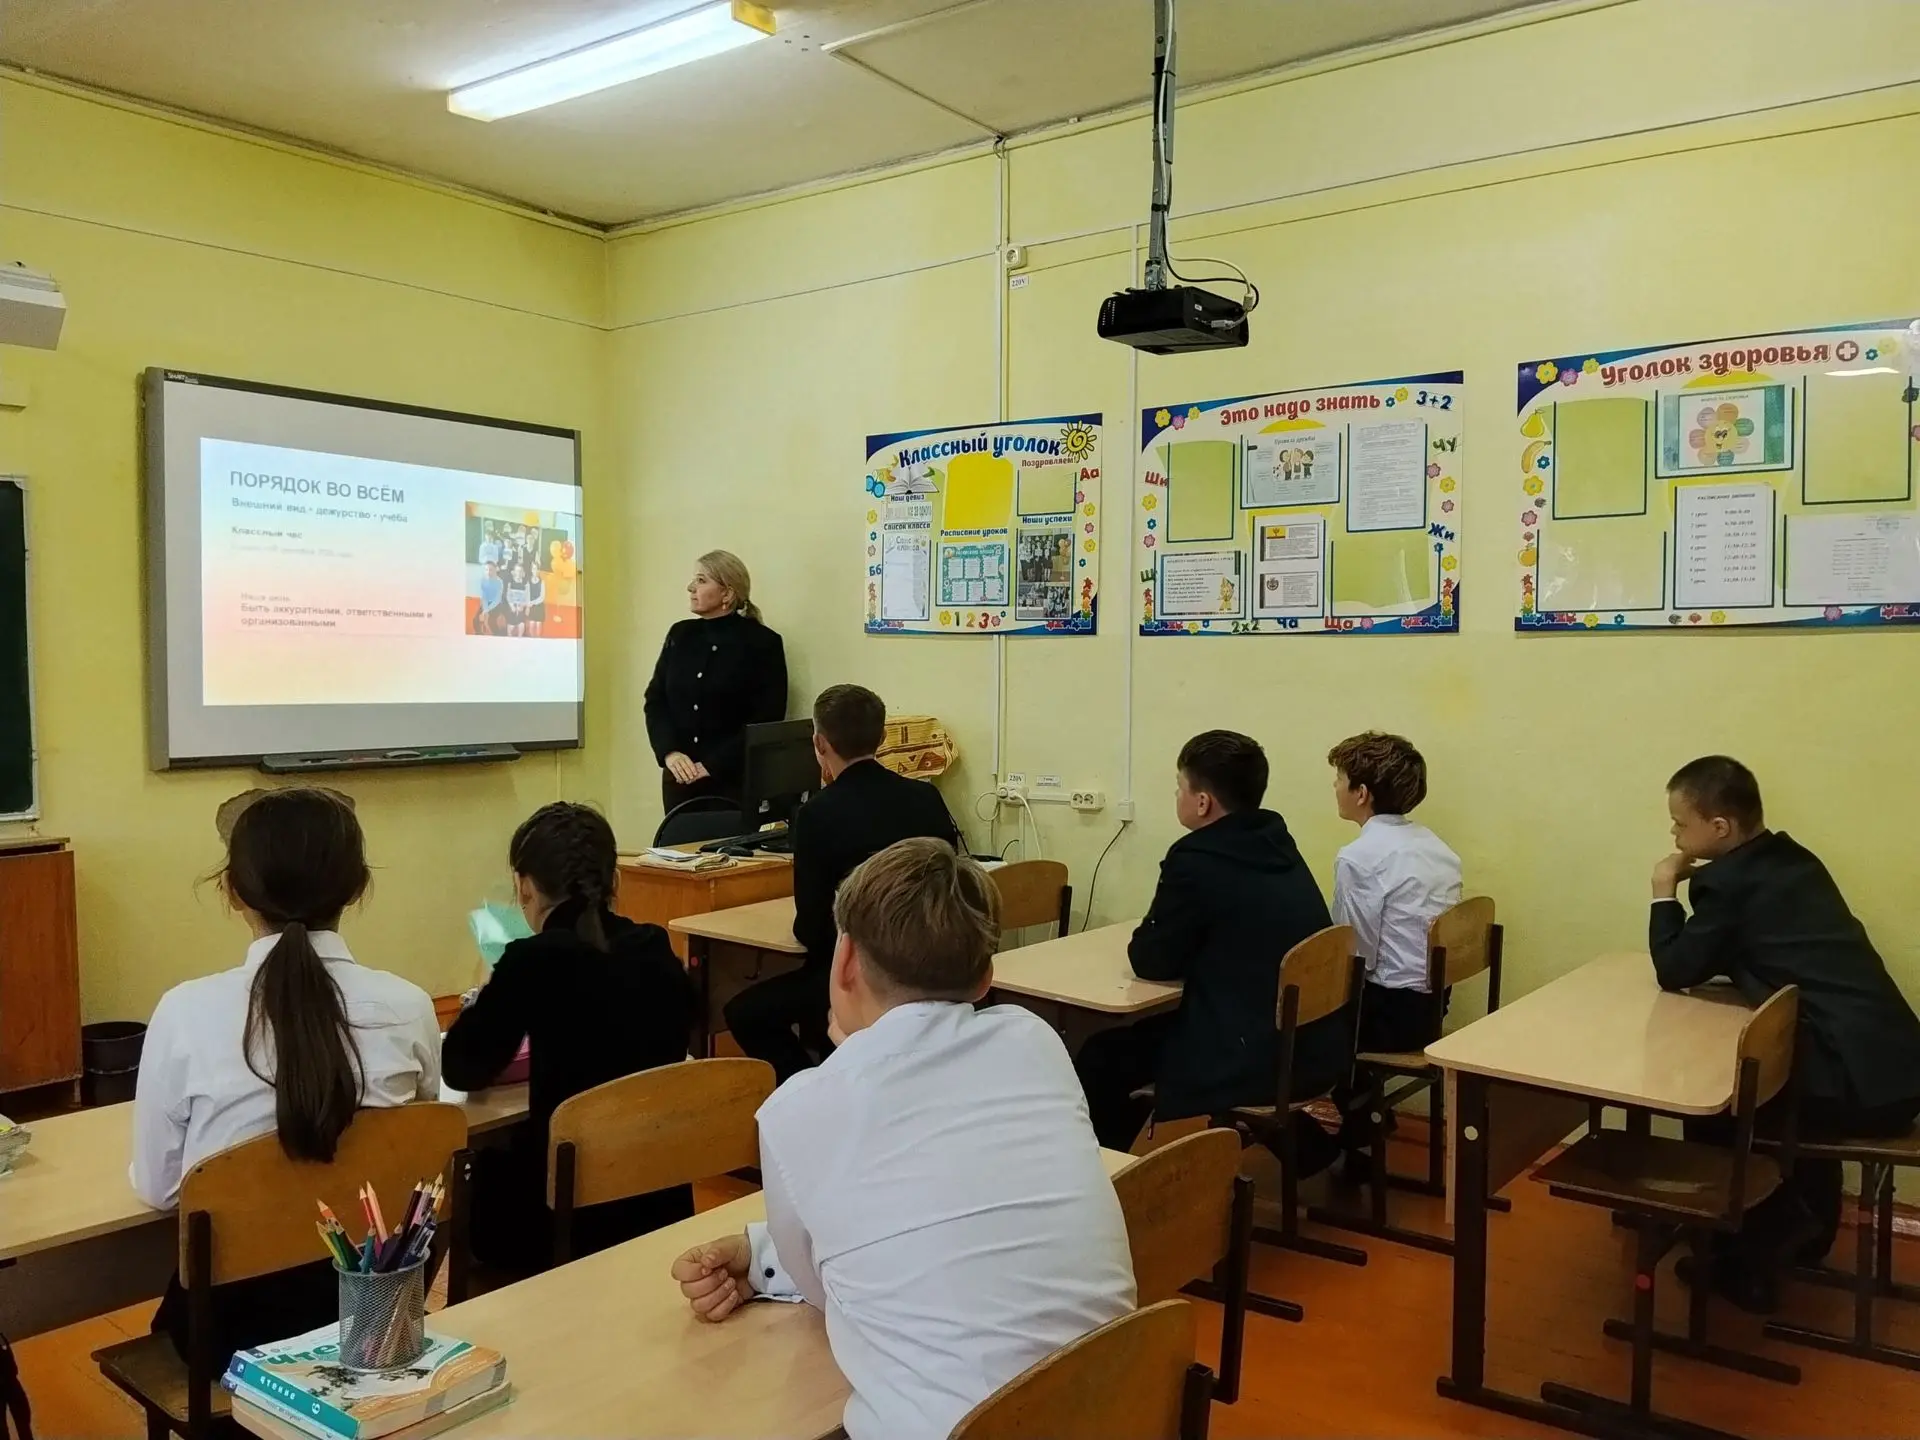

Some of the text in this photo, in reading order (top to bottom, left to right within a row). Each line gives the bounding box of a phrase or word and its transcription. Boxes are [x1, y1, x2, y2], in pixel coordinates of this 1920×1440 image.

[1601, 344, 1829, 385] Уголок здоровья
[1416, 390, 1452, 410] 3+2
[1220, 394, 1380, 426] Это надо знать
[899, 432, 1061, 468] Классный уголок
[1022, 456, 1077, 469] Поздравляем!
[1080, 467, 1099, 481] Аа
[230, 471, 404, 503] ПОРЯДОК ВО ВСЁМ
[232, 497, 283, 511] Внешний
[287, 504, 306, 513] вид
[316, 507, 371, 519] дежурство
[1022, 516, 1072, 525] Наши успехи
[941, 528, 1008, 537] Расписание уроков
[241, 617, 336, 628] организованными
[955, 611, 989, 629] 1 2 3
